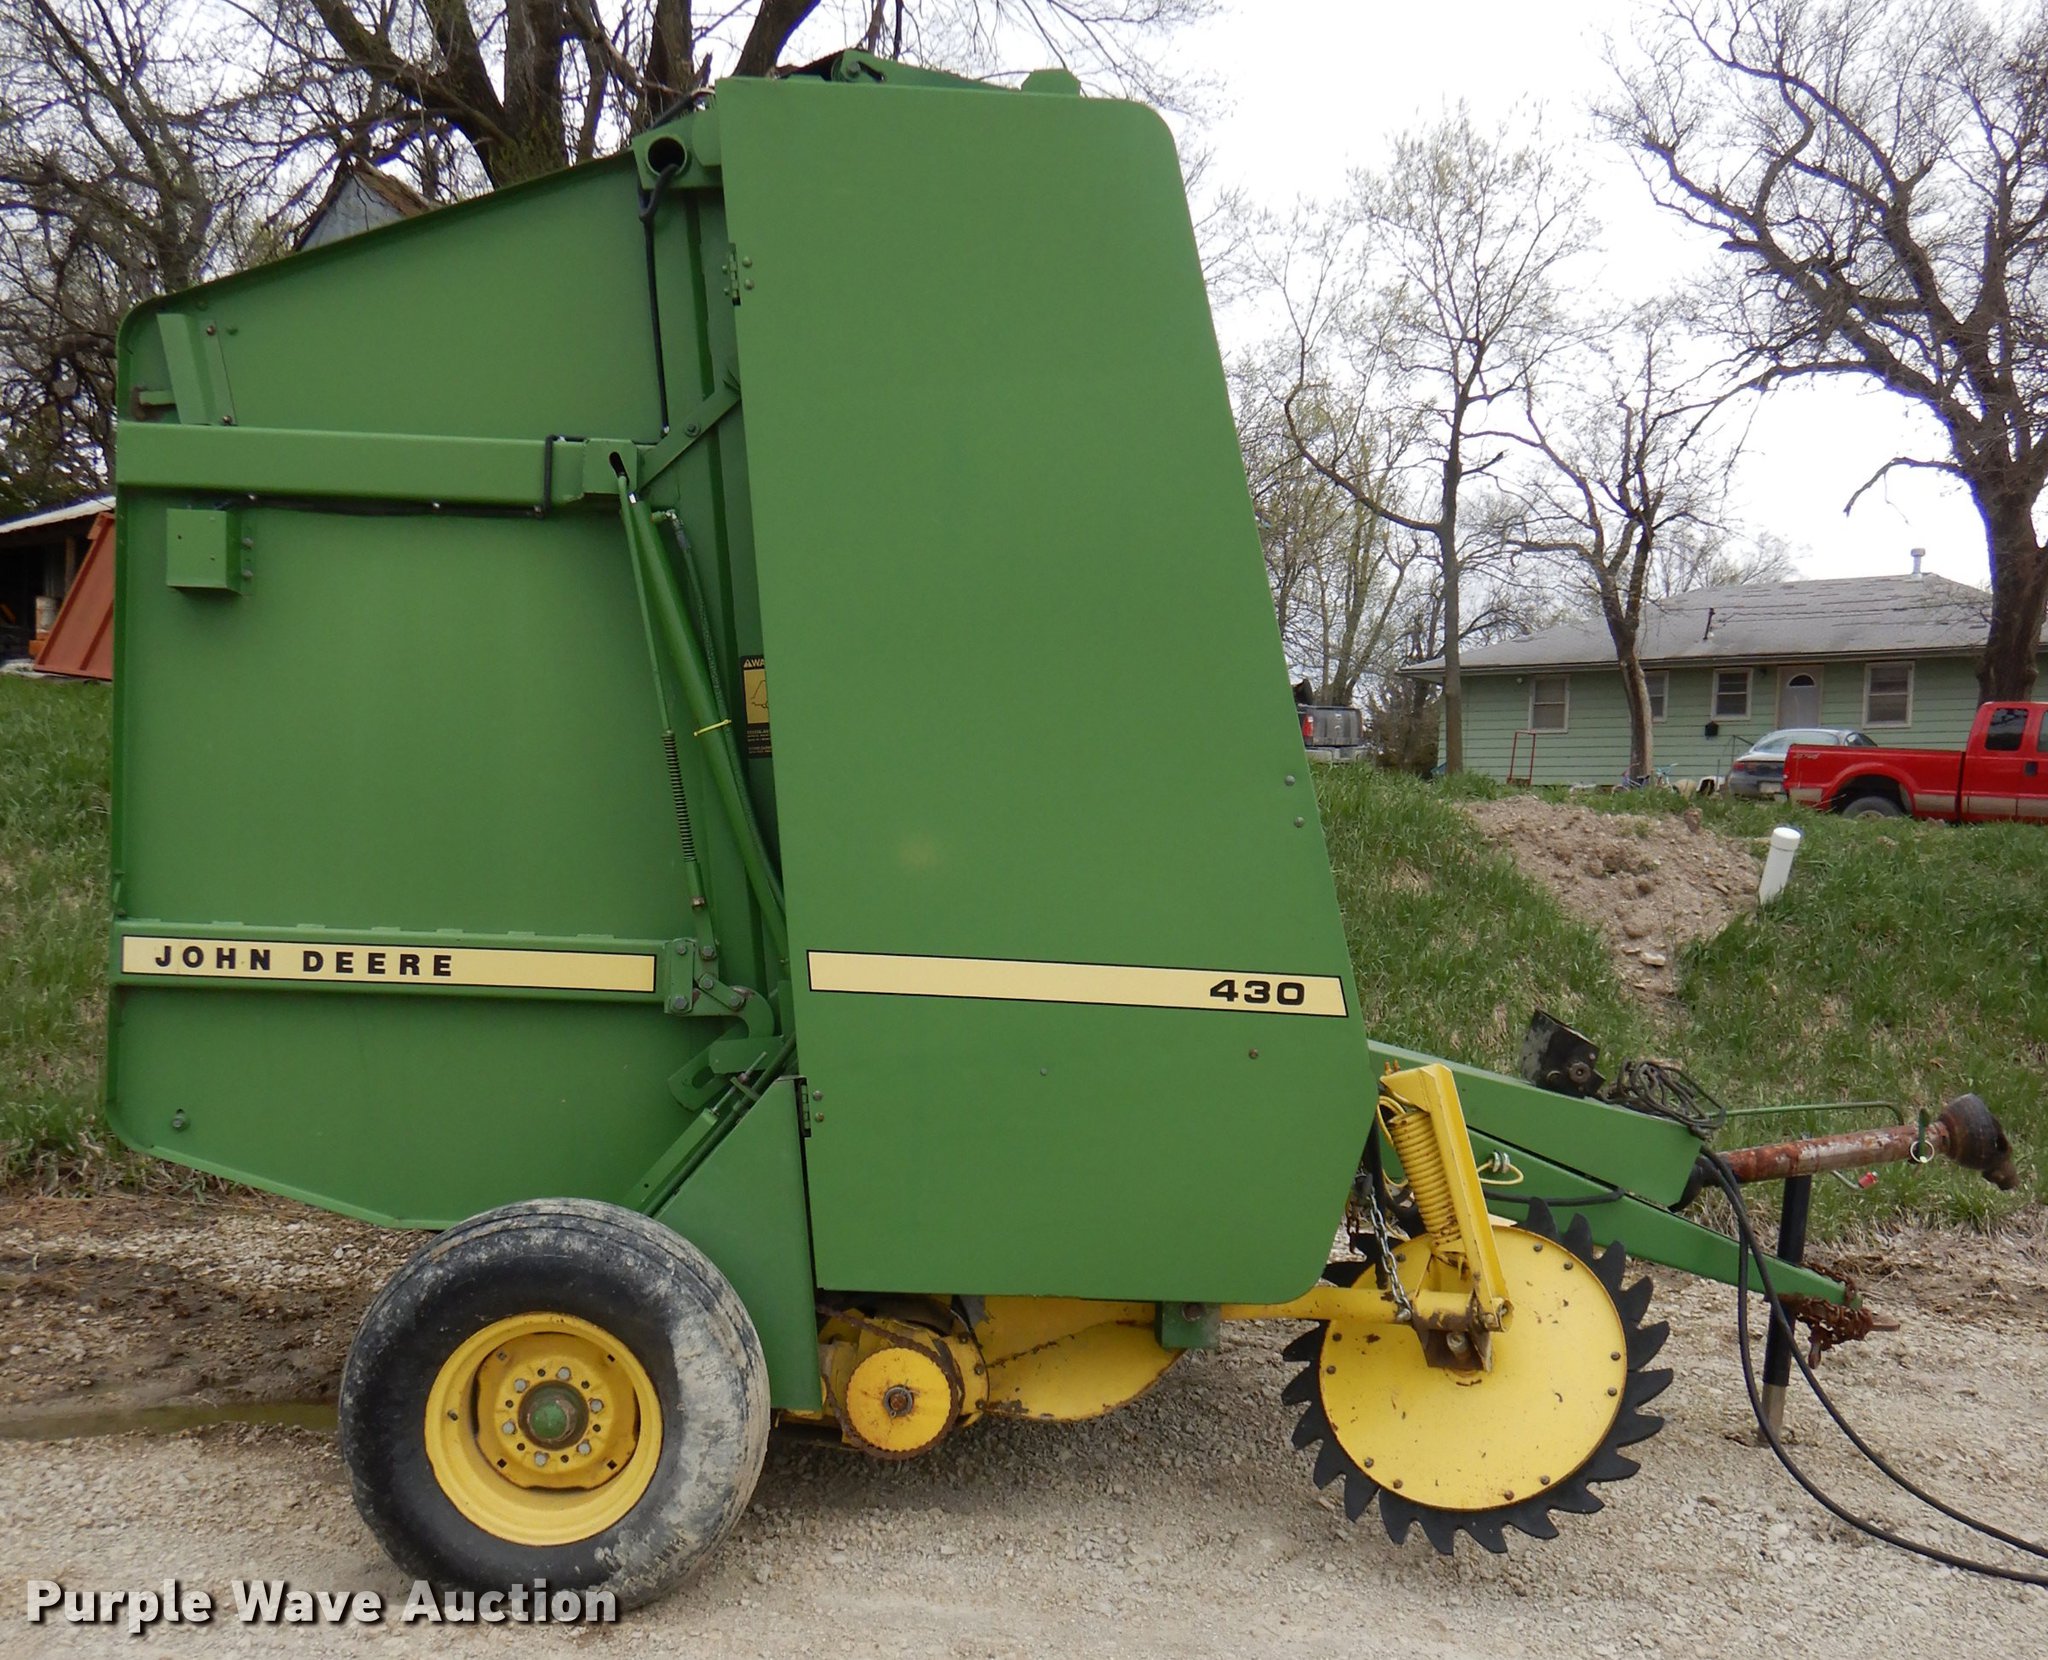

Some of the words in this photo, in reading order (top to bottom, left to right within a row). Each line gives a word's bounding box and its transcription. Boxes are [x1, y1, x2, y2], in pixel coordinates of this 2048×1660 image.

[155, 946, 271, 970] JOHN
[303, 950, 451, 976] DEERE
[1209, 979, 1305, 1006] 430
